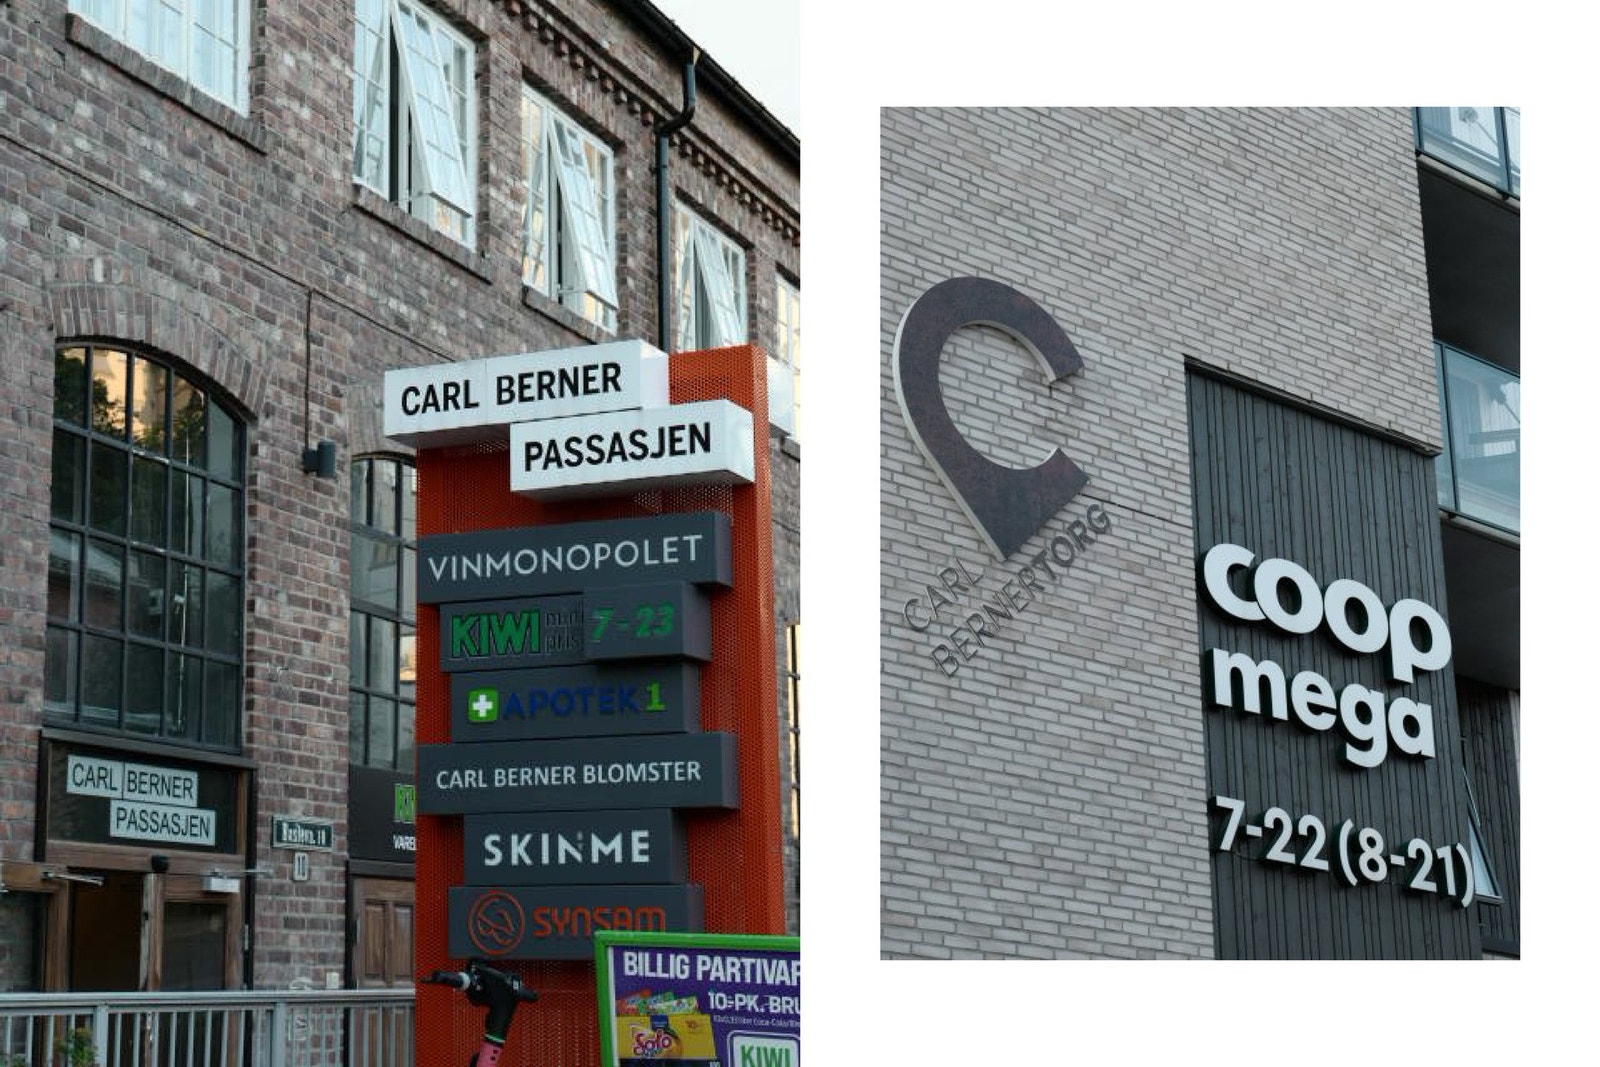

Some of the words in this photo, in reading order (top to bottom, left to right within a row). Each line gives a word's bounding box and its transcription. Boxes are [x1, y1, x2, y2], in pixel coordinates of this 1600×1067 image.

[400, 380, 479, 416] CARL
[496, 361, 622, 406] BERNER
[523, 422, 712, 472] PASSASJEN
[427, 534, 703, 582] VINMONOPOLET
[904, 559, 984, 632] CARL
[930, 503, 1112, 679] BERNERTORG
[1203, 543, 1453, 684] coop
[451, 609, 541, 658] KIWI
[502, 687, 642, 720] APOTEK
[646, 680, 666, 713] 1
[1212, 647, 1436, 768] mega
[72, 763, 118, 791] CARL
[127, 771, 194, 800] BERNER
[436, 770, 488, 790] CARL
[493, 766, 576, 788] BERNER
[582, 760, 702, 784] BLOMSTER
[115, 807, 212, 838] PASSASJEN
[1215, 795, 1330, 872] 7-22
[1339, 818, 1475, 908] (8-21)
[623, 951, 690, 980] BILLIG
[741, 1045, 791, 1067] KIWI
